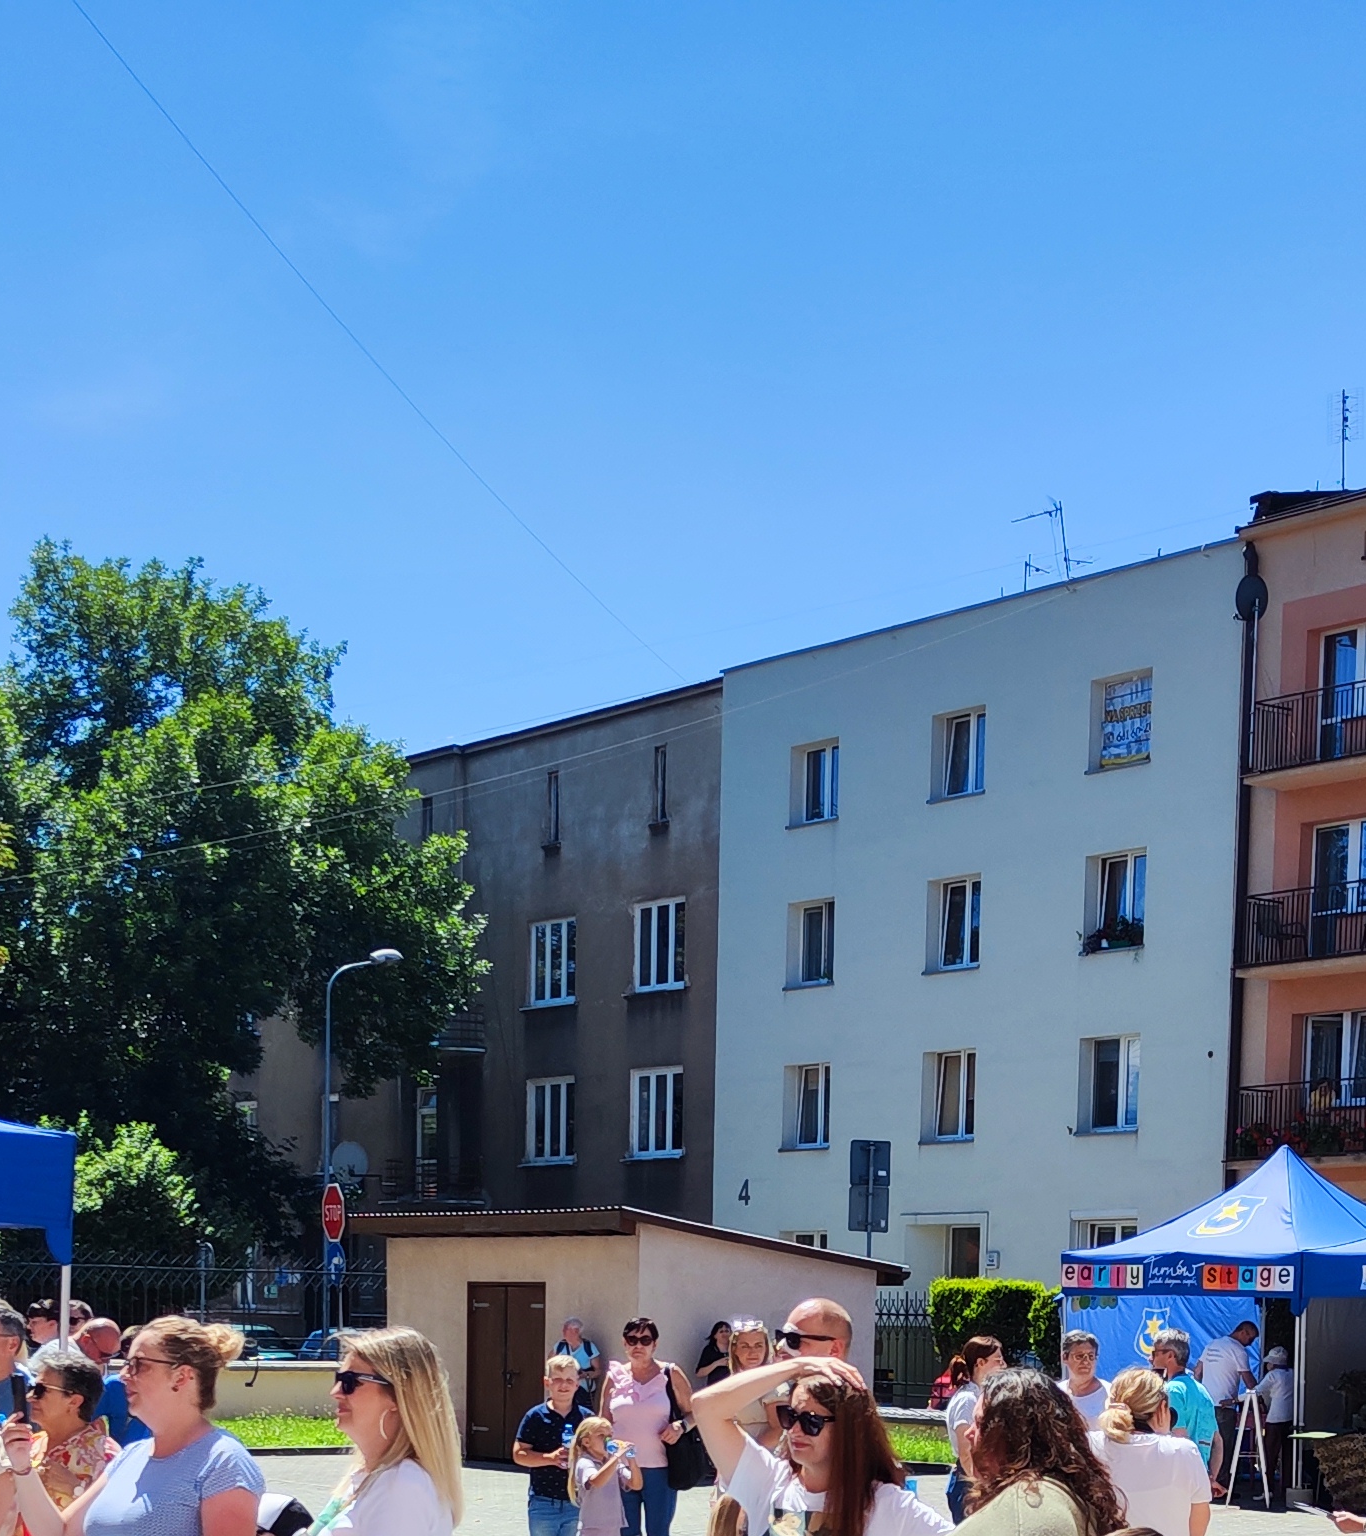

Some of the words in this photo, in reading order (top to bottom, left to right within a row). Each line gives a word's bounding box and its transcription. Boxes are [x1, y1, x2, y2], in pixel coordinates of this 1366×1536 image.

[737, 1178, 751, 1206] 4
[324, 1204, 342, 1221] STOP
[1064, 1265, 1141, 1286] early
[1205, 1267, 1291, 1288] stage
[1143, 1255, 1206, 1280] Tarnów
